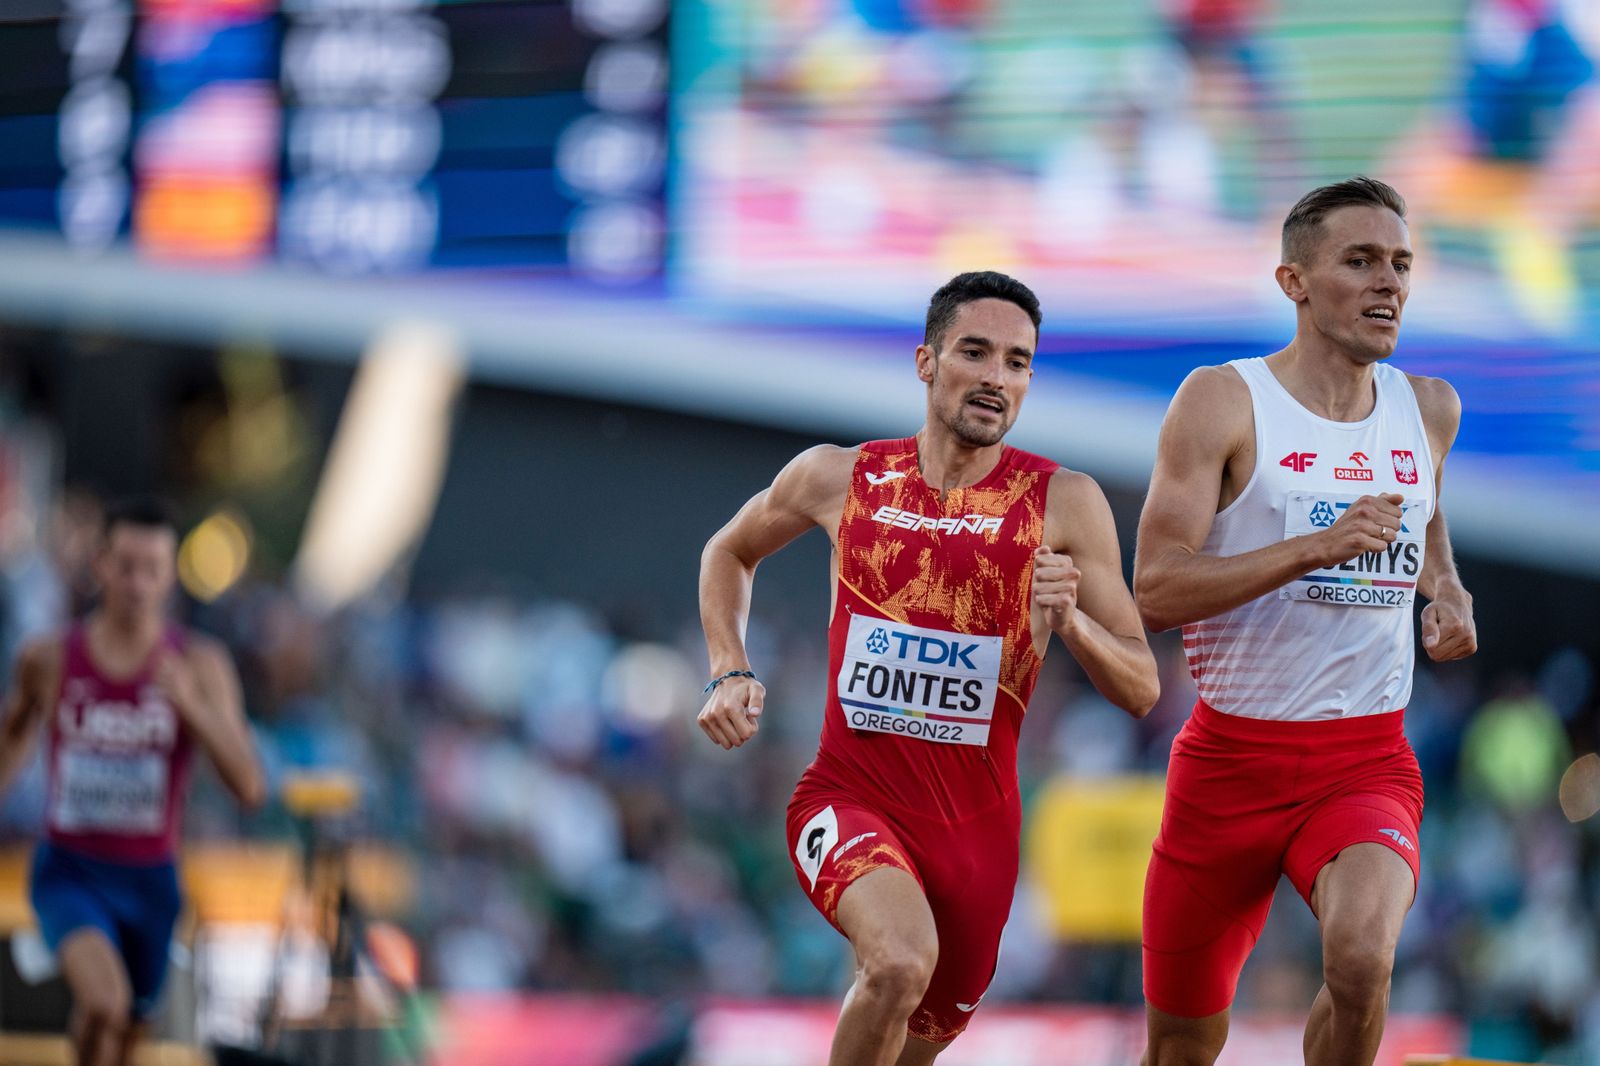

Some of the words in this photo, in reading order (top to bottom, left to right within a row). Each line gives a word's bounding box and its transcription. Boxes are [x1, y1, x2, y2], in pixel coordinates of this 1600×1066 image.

[1279, 451, 1317, 472] 4F
[1336, 469, 1371, 480] ORLEN
[871, 505, 1005, 535] ESPAÑA
[1322, 542, 1419, 576] MYS
[1307, 585, 1405, 606] OREGON22
[891, 631, 980, 670] TDK
[847, 661, 983, 712] FONTES
[851, 711, 963, 741] OREGON22
